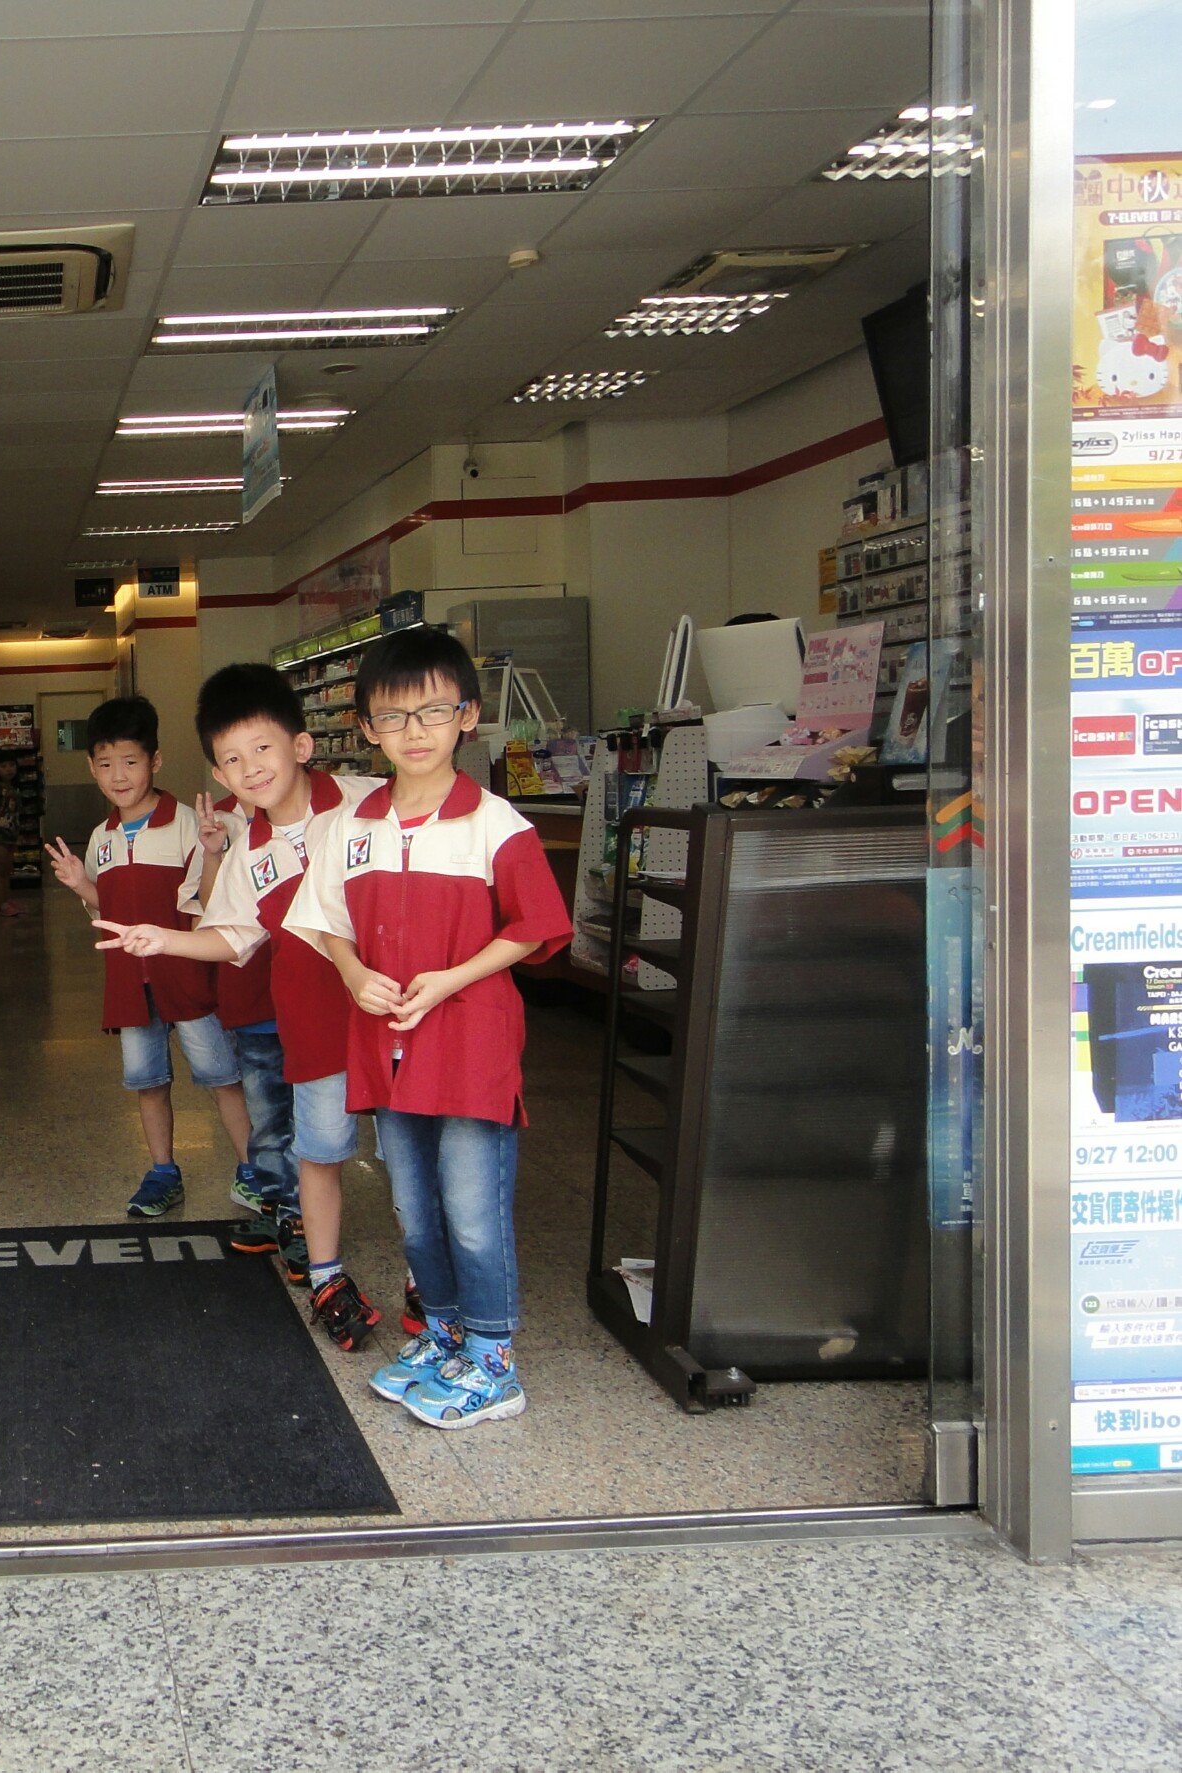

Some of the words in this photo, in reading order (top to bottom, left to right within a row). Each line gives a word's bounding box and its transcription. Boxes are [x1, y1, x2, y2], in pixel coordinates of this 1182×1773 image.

[1121, 431, 1156, 442] Zyliss
[147, 584, 173, 596] ATM
[1073, 787, 1182, 815] OPEN
[1075, 1147, 1117, 1166] 9/27
[1124, 1144, 1179, 1163] 12:00
